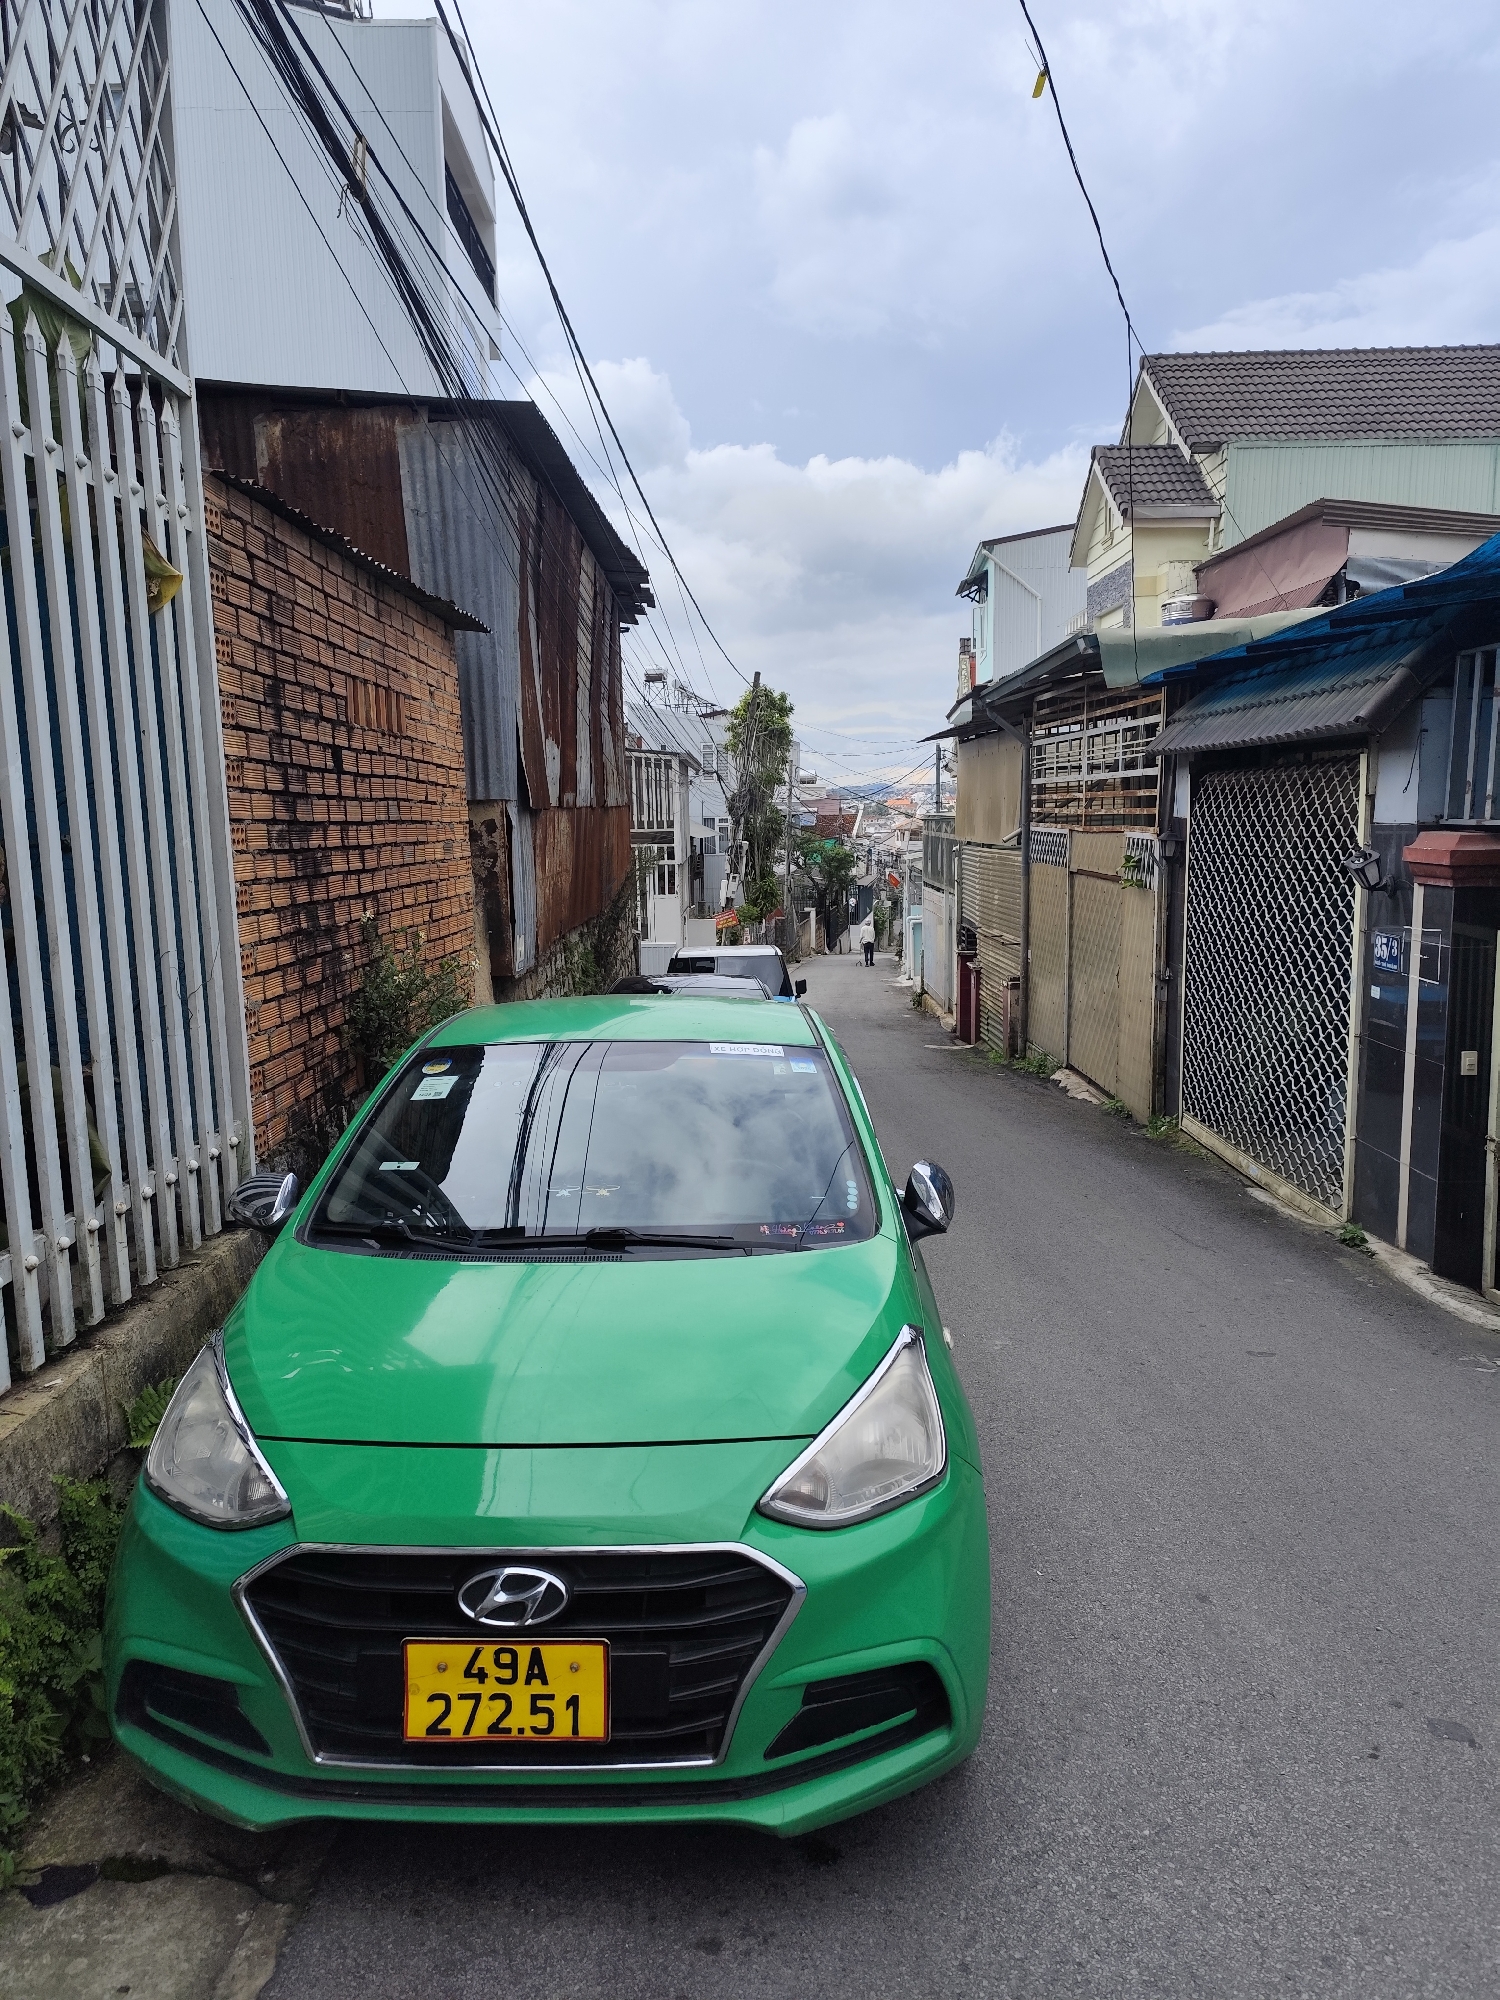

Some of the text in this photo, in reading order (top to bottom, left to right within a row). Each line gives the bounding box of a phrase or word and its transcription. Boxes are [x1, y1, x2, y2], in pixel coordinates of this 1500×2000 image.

[1375, 935, 1398, 961] 35/3
[463, 1646, 549, 1686] 49A
[425, 1692, 580, 1736] 272.51
